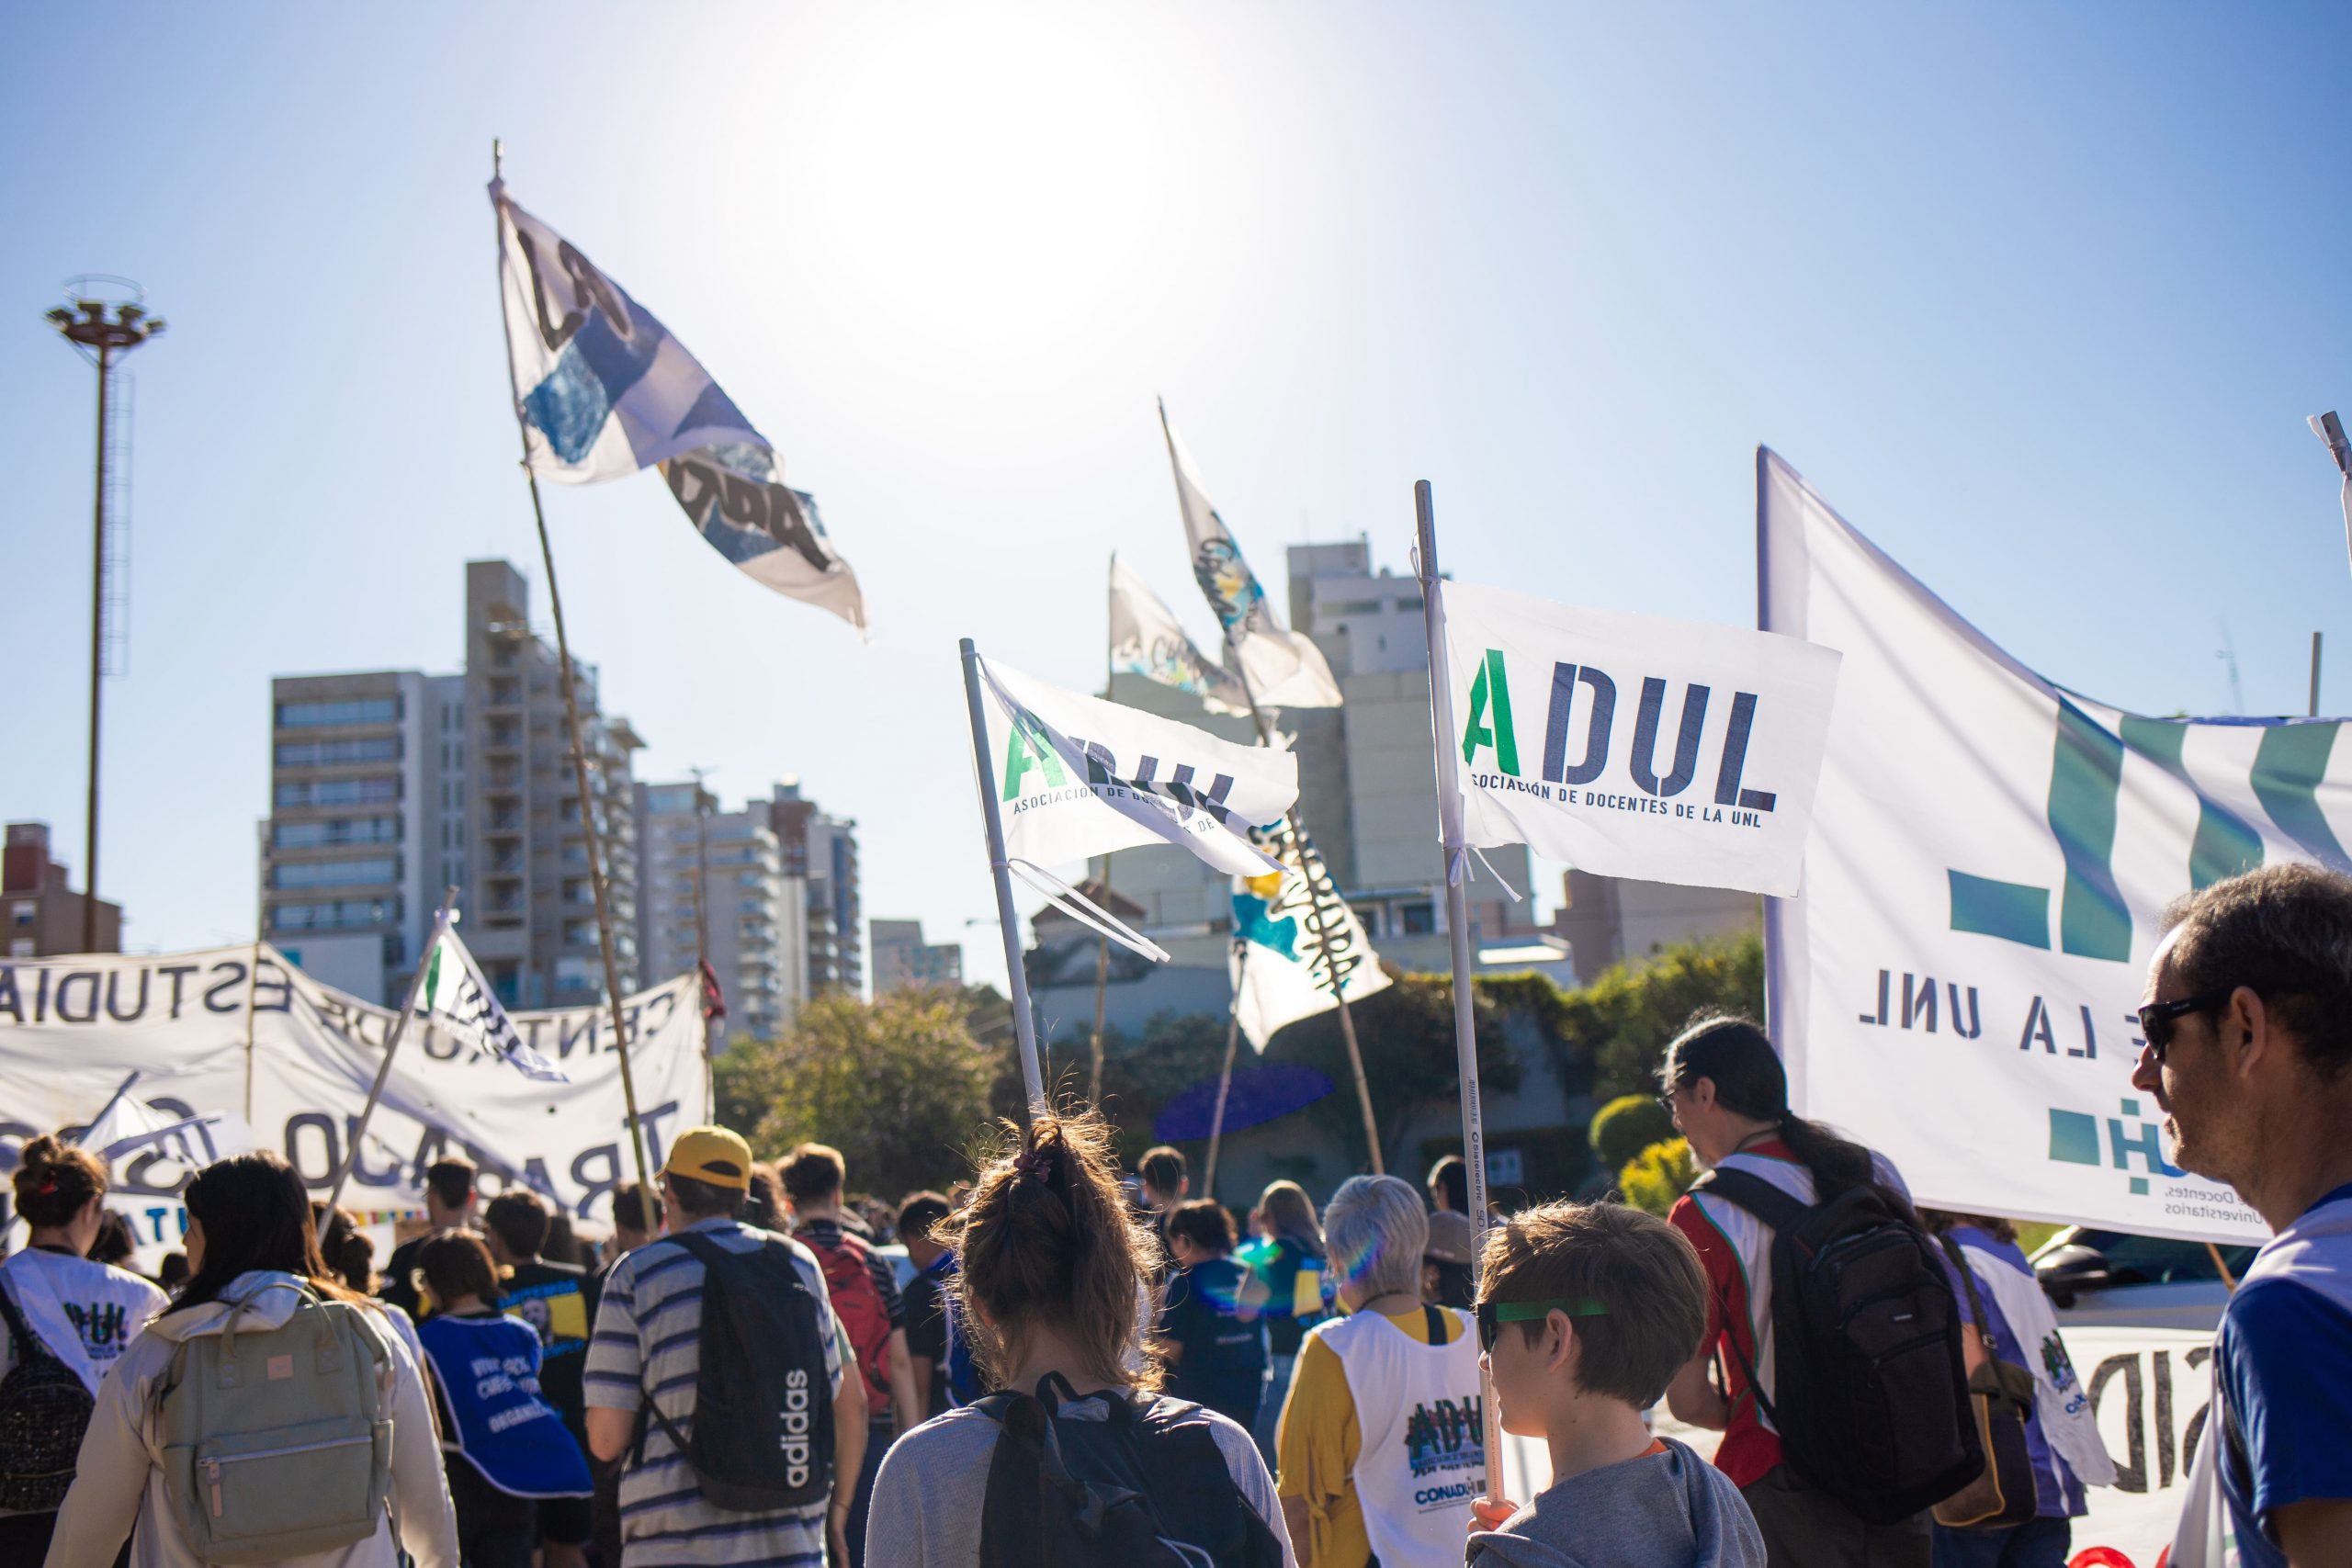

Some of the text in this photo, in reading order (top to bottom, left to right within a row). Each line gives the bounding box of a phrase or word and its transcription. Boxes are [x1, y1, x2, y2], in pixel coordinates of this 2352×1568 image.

[1463, 649, 1777, 812] ADUL
[1013, 786, 1125, 816] ASOCIACIÓN DE
[1472, 773, 1762, 829] SOCIACIÓN DE DOCENTES DE LA UNL
[779, 1369, 809, 1488] adidas
[1412, 1395, 1483, 1461] ADU
